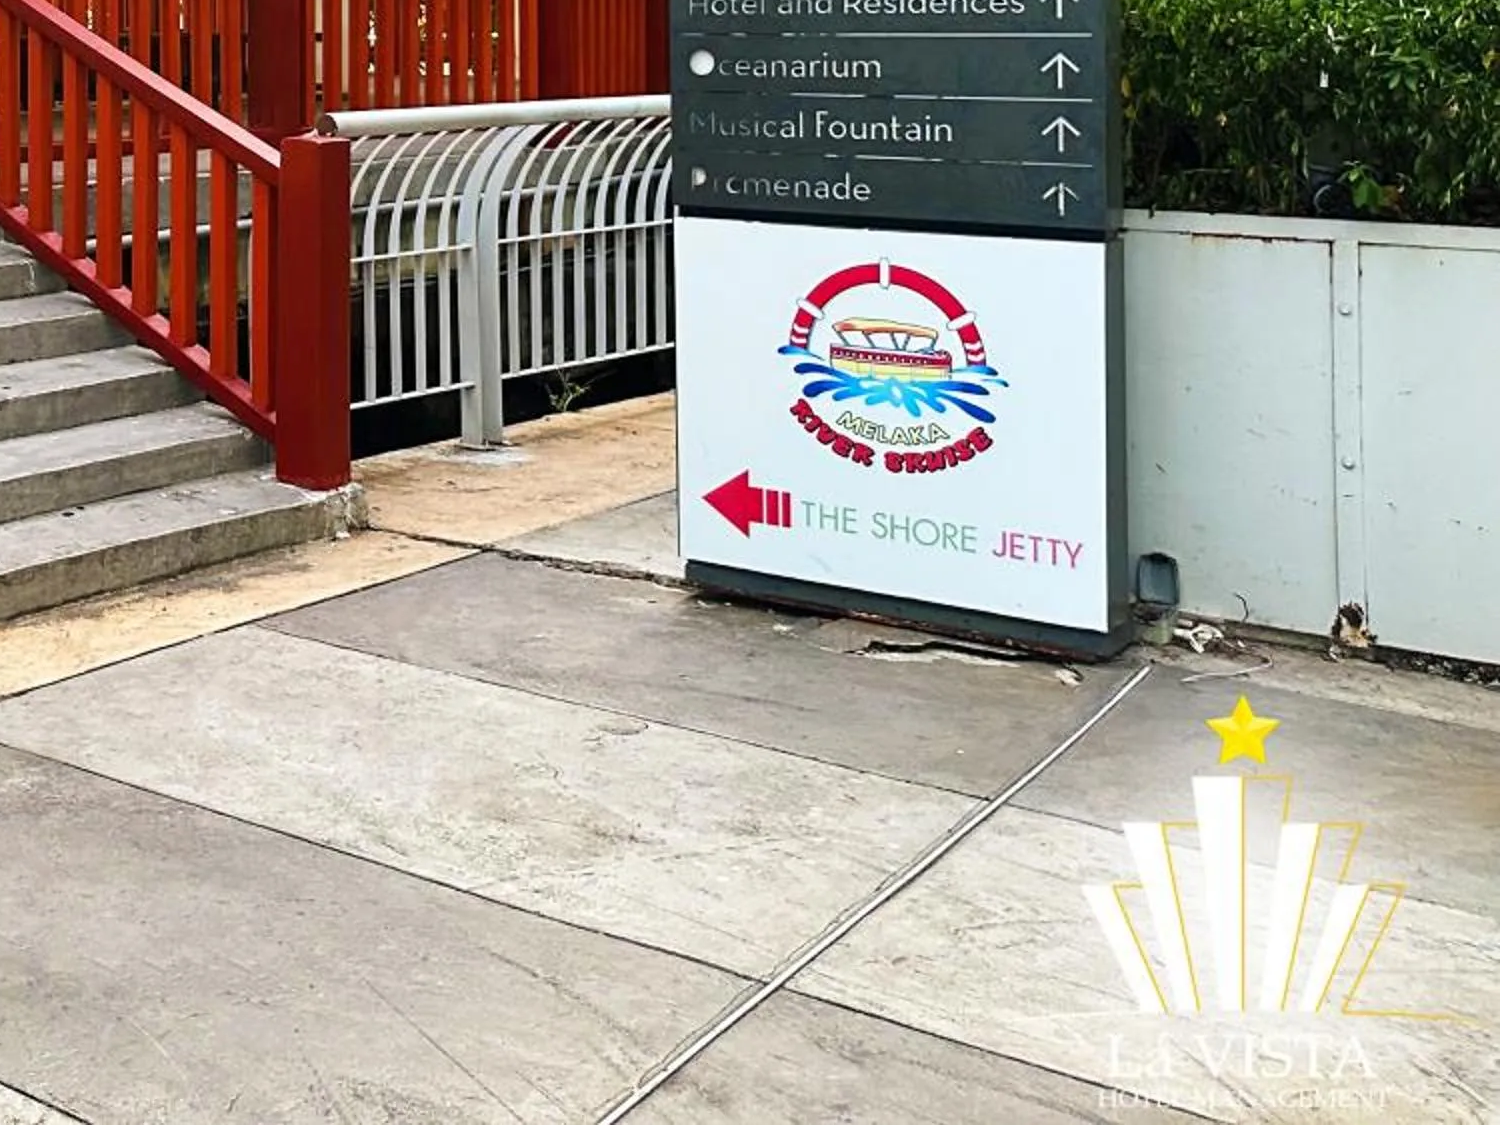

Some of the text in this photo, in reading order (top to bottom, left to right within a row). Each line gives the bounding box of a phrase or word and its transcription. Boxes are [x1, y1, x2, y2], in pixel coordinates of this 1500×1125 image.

[689, 49, 882, 78] Oceanarium
[689, 110, 953, 143] Musical Fountain
[789, 397, 994, 474] RIVER CRUISE
[835, 410, 951, 446] MELAKA
[799, 499, 1084, 570] THE SHORE JETTY
